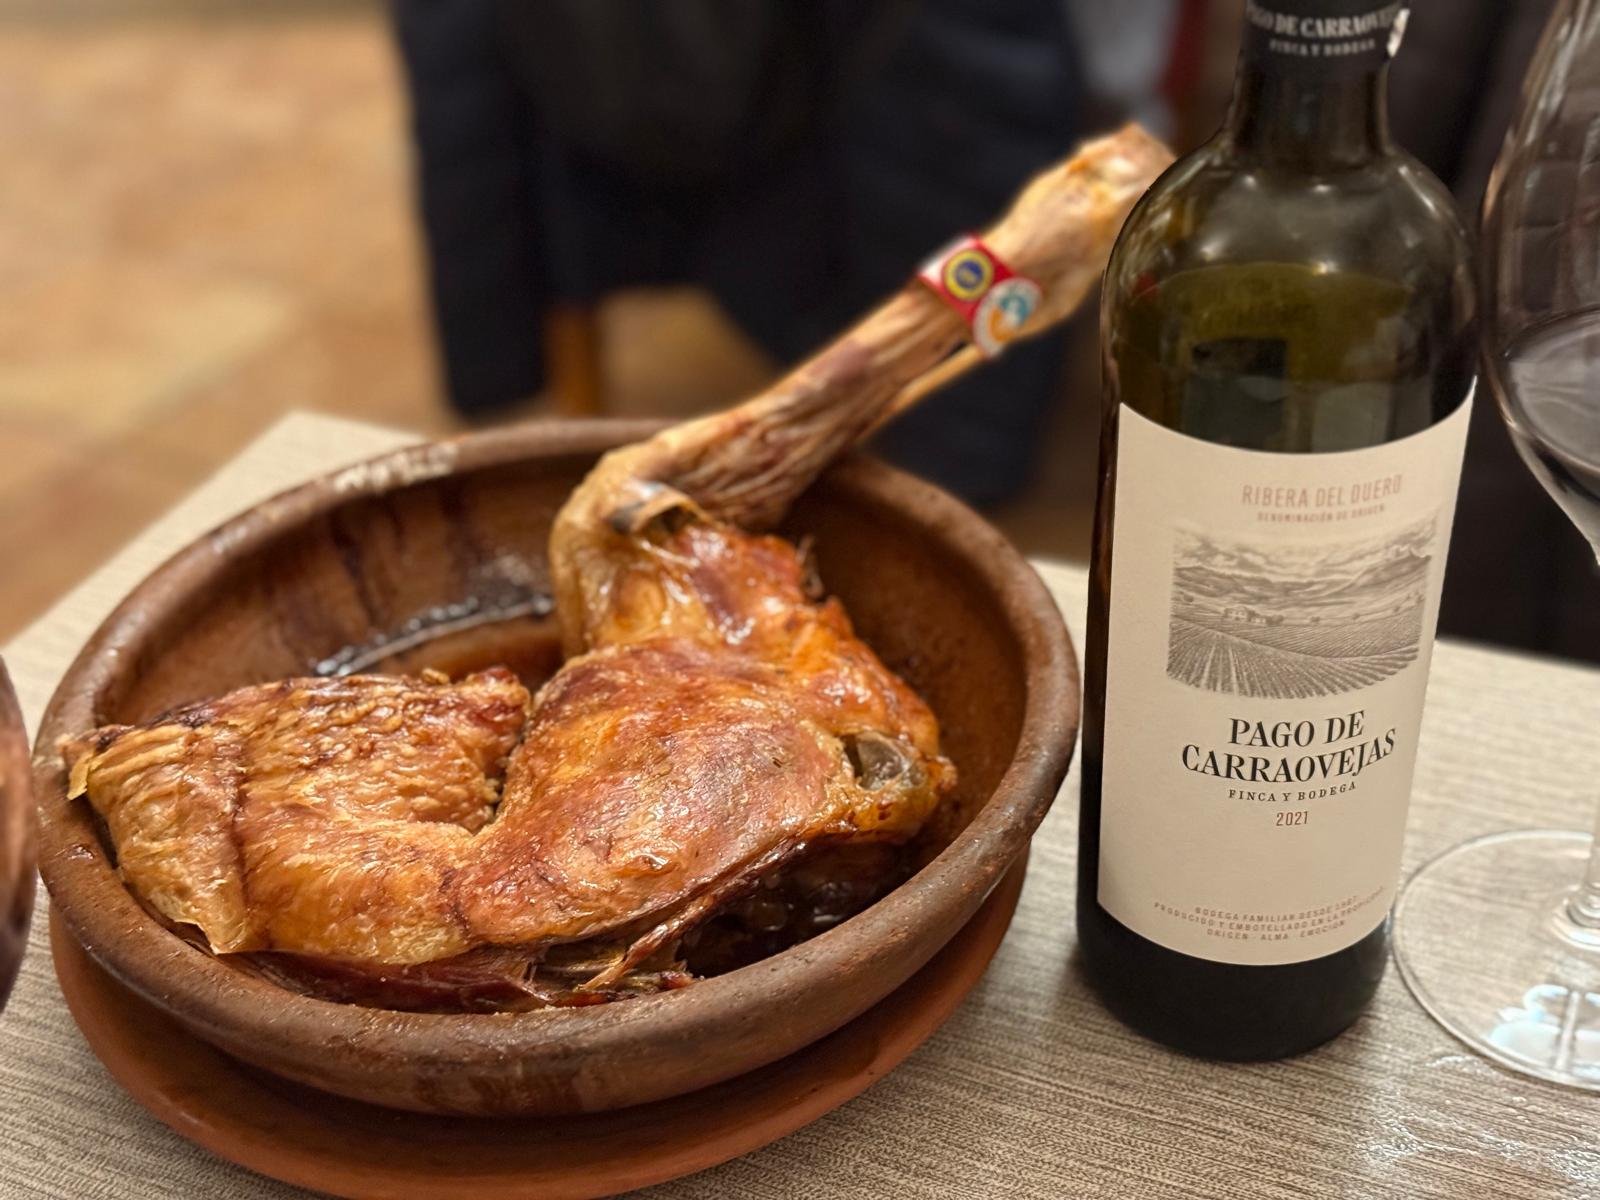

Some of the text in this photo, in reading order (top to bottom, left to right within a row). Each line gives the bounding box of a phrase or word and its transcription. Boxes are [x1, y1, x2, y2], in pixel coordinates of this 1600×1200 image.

[1241, 474, 1403, 508] RIBERA DEL DUERO
[1228, 710, 1365, 748] PAGO DE
[1182, 728, 1396, 783] CARRAOVEJAS
[1228, 781, 1357, 802] FINCA Y BODEGA
[1275, 811, 1309, 827] 2021
[1154, 902, 1216, 926] PRODUCIDO
[1229, 920, 1309, 932] EMBOTELLADO
[1195, 906, 1239, 921] BODEGA
[1243, 913, 1295, 923] FAMILIAR
[1298, 906, 1333, 919] DESDE
[1207, 928, 1249, 940] ORIGEN
